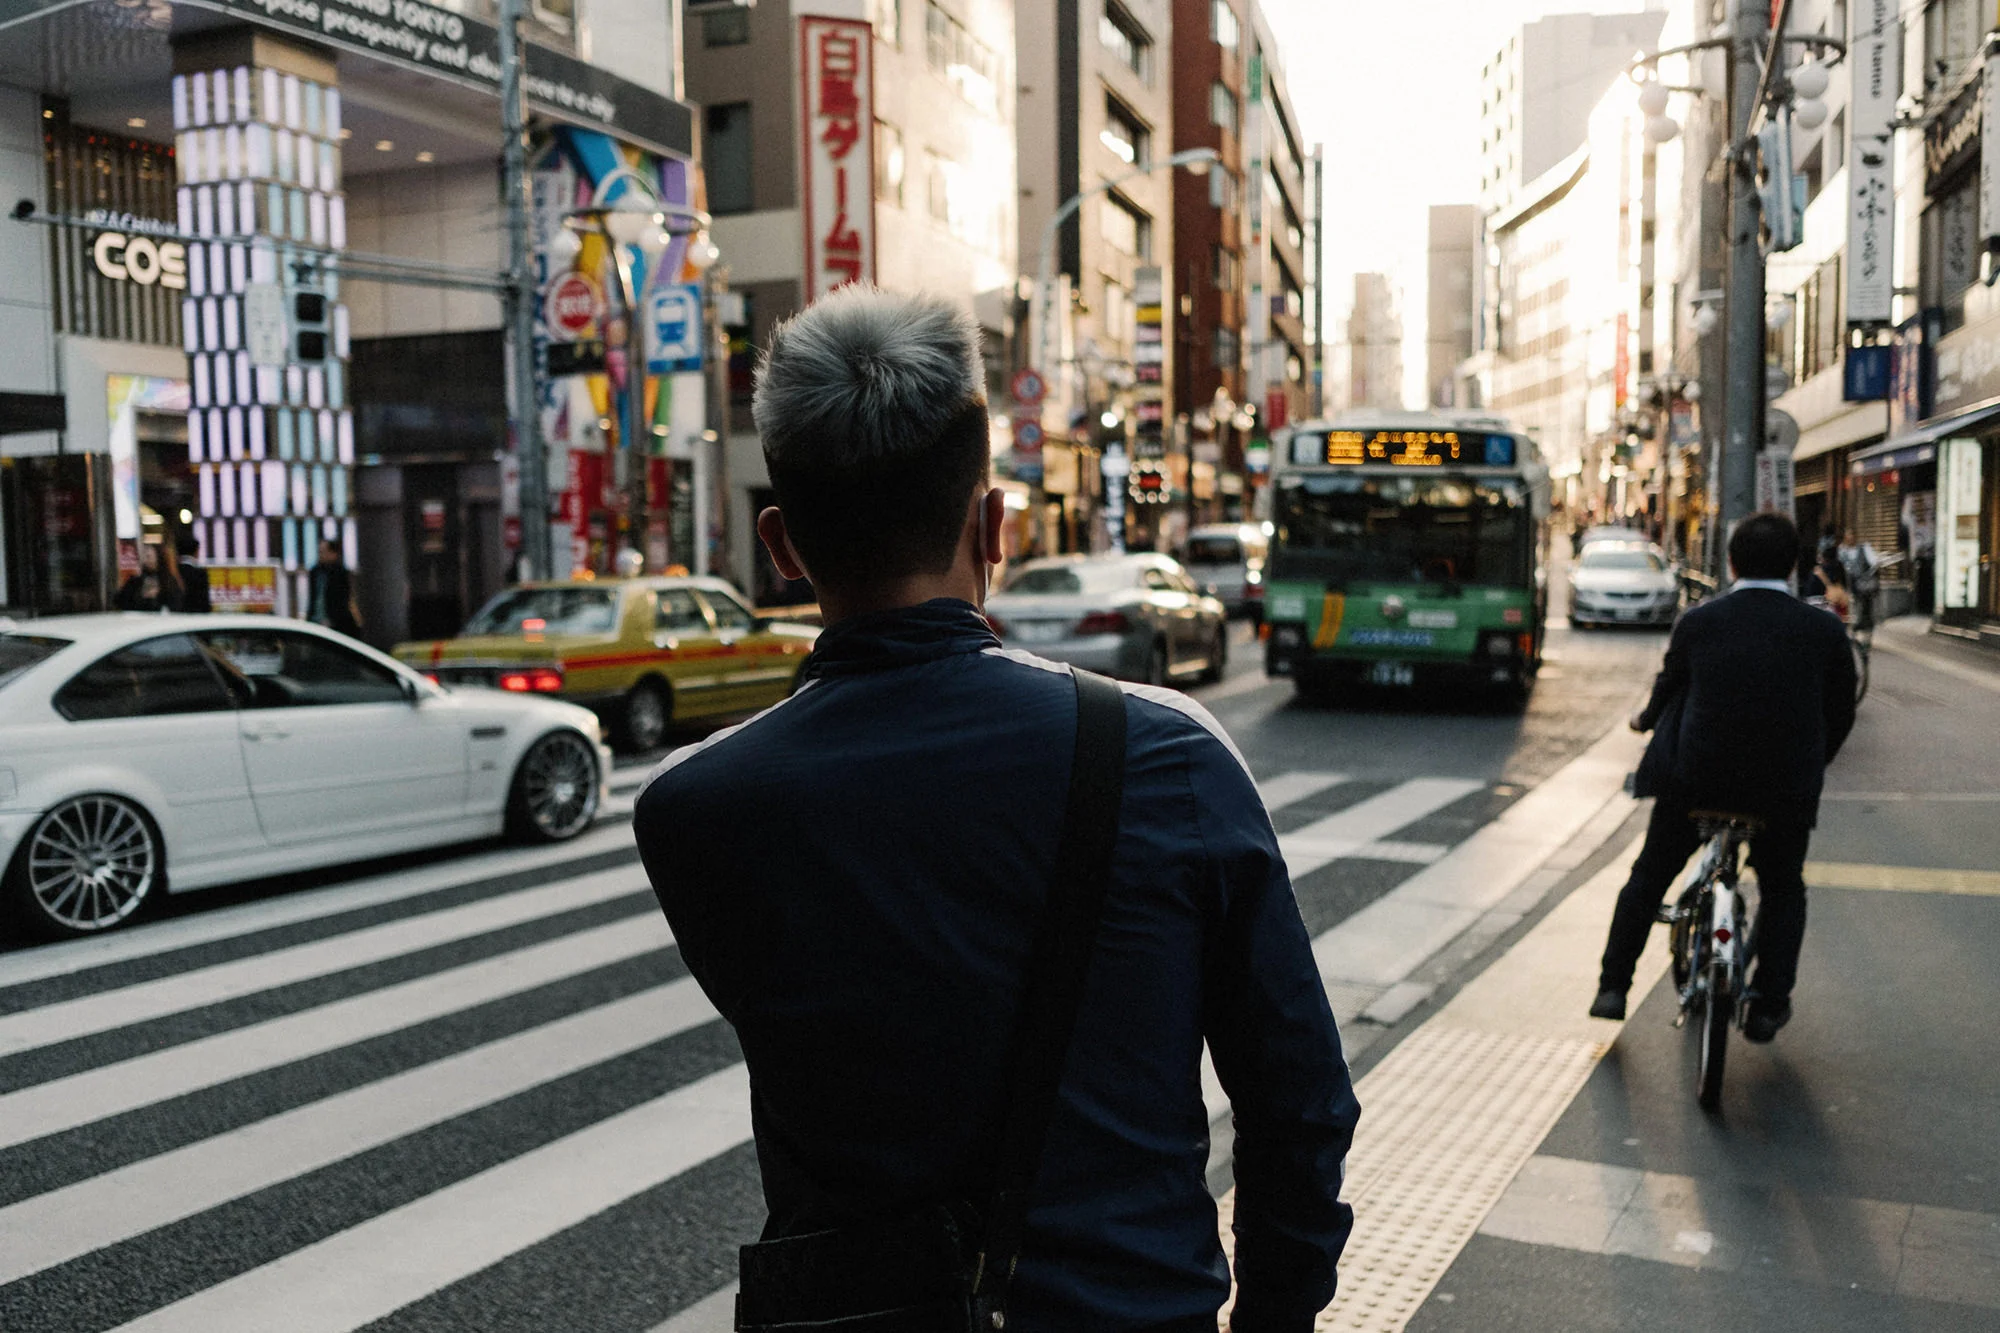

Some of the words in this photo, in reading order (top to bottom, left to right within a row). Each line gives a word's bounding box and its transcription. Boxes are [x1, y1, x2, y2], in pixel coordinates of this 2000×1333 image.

[322, 7, 428, 61] prosperity
[429, 42, 469, 69] and
[392, 0, 464, 41] TOKYO
